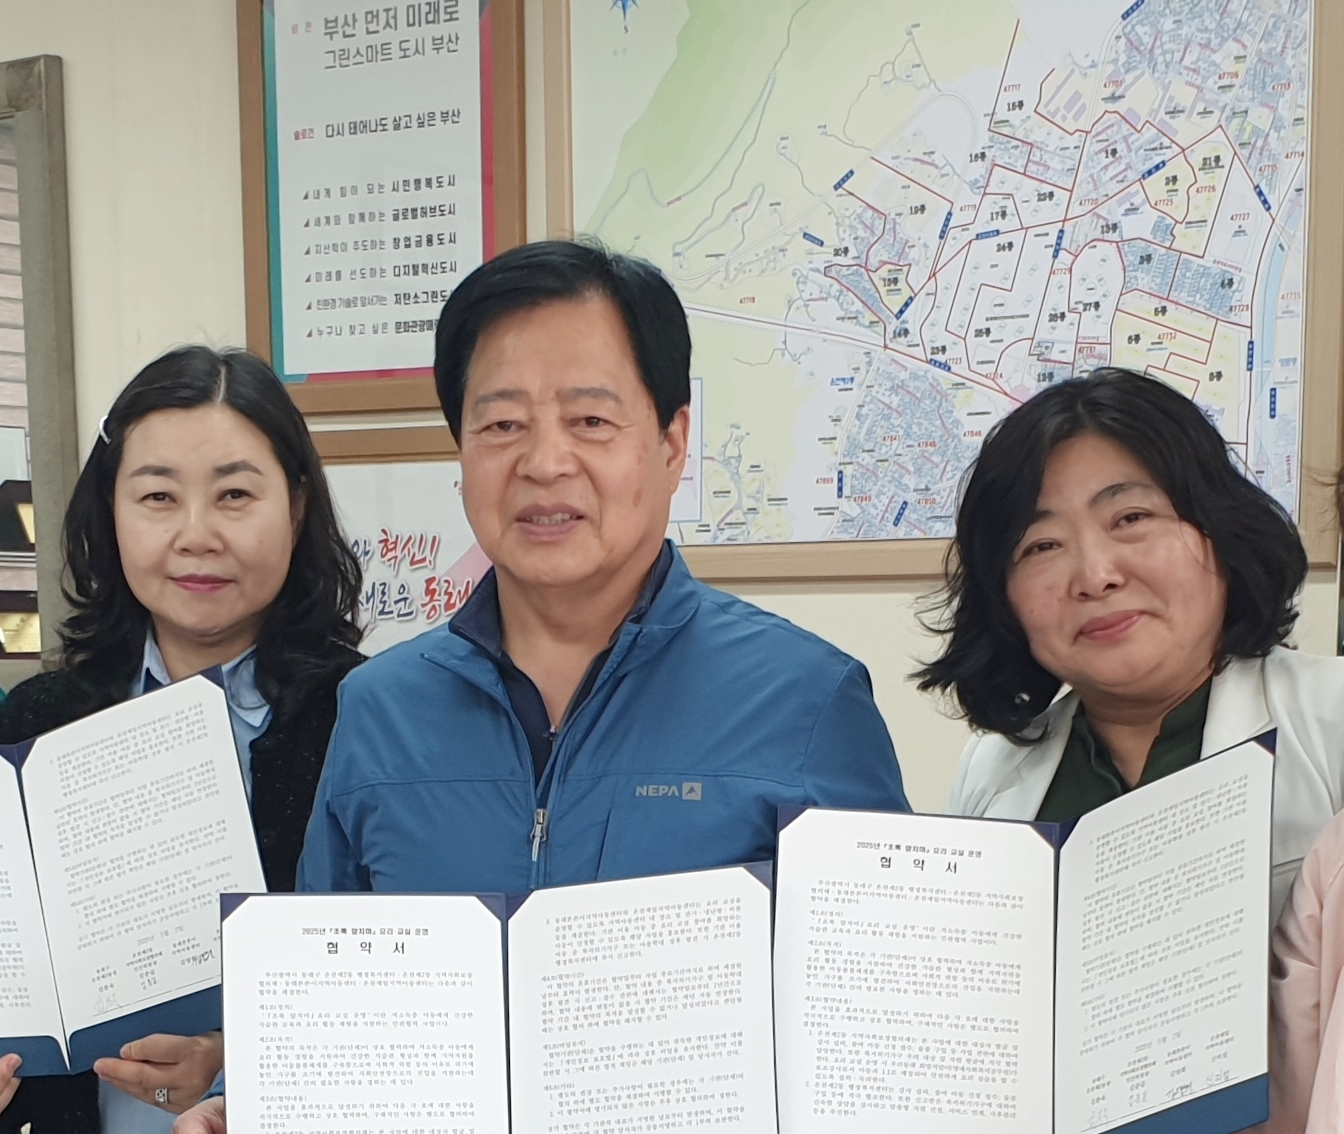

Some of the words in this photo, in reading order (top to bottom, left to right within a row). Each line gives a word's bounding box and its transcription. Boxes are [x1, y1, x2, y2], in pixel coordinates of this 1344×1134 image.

[324, 13, 358, 41] 부산
[364, 7, 398, 36] 먼저
[406, 0, 459, 28] 미래로
[324, 42, 393, 70] 그린스마트
[398, 38, 425, 59] 도시
[431, 32, 460, 55] 부산
[325, 122, 345, 138] 다시
[348, 117, 389, 136] 태어나도
[392, 114, 412, 131] 살고
[416, 111, 436, 128] 싶은
[440, 108, 461, 125] 부산
[391, 174, 455, 193] 시민행복도시
[392, 203, 456, 222] 글로벌허브도시
[393, 260, 456, 278] 디지털혁신도시
[394, 289, 454, 306] 저탄소그린도
[378, 528, 439, 573] 혁신!
[421, 576, 471, 621] 동래
[636, 785, 680, 796] NEPA
